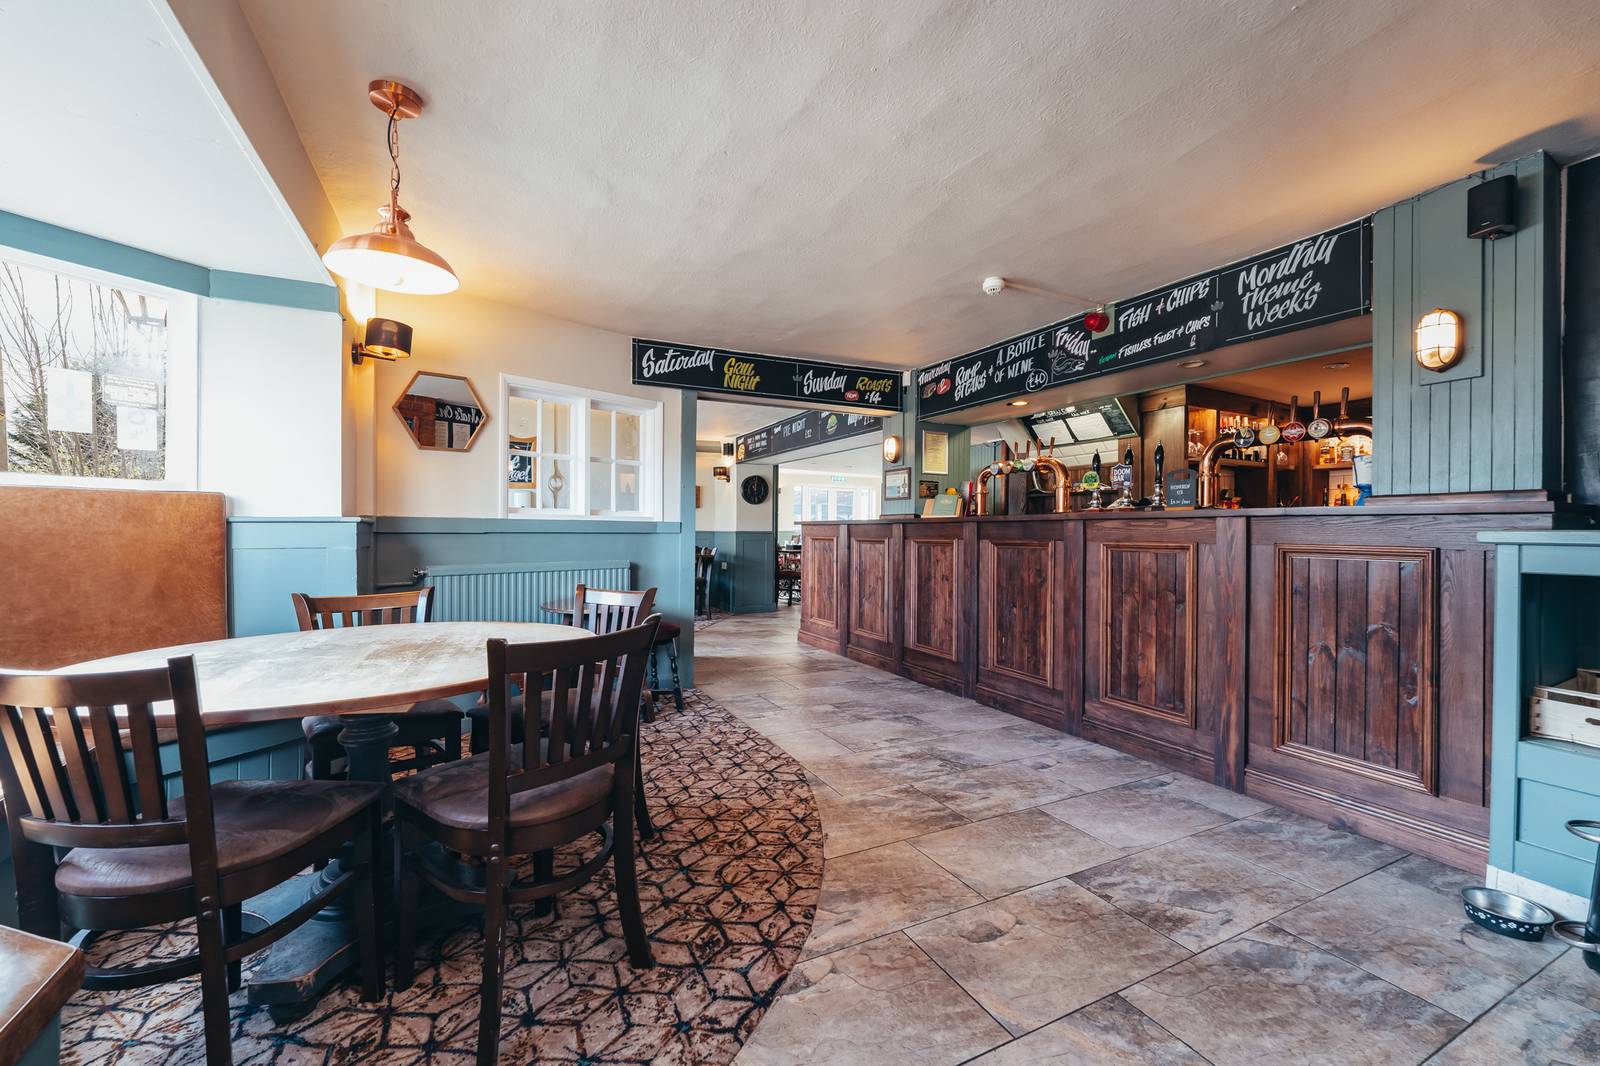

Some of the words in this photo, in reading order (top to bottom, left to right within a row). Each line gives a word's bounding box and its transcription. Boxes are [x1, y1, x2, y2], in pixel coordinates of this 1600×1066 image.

[1237, 234, 1338, 295] Monthly
[1119, 303, 1152, 333] FISH
[1166, 278, 1210, 312] CHIPS
[1185, 315, 1211, 335] CHIPS
[1005, 333, 1046, 364] BOTTLE
[1056, 326, 1090, 362] Friday
[642, 348, 714, 378] Saturday
[994, 367, 1006, 384] OF
[1007, 357, 1035, 380] WINE
[803, 369, 848, 395] Sunday
